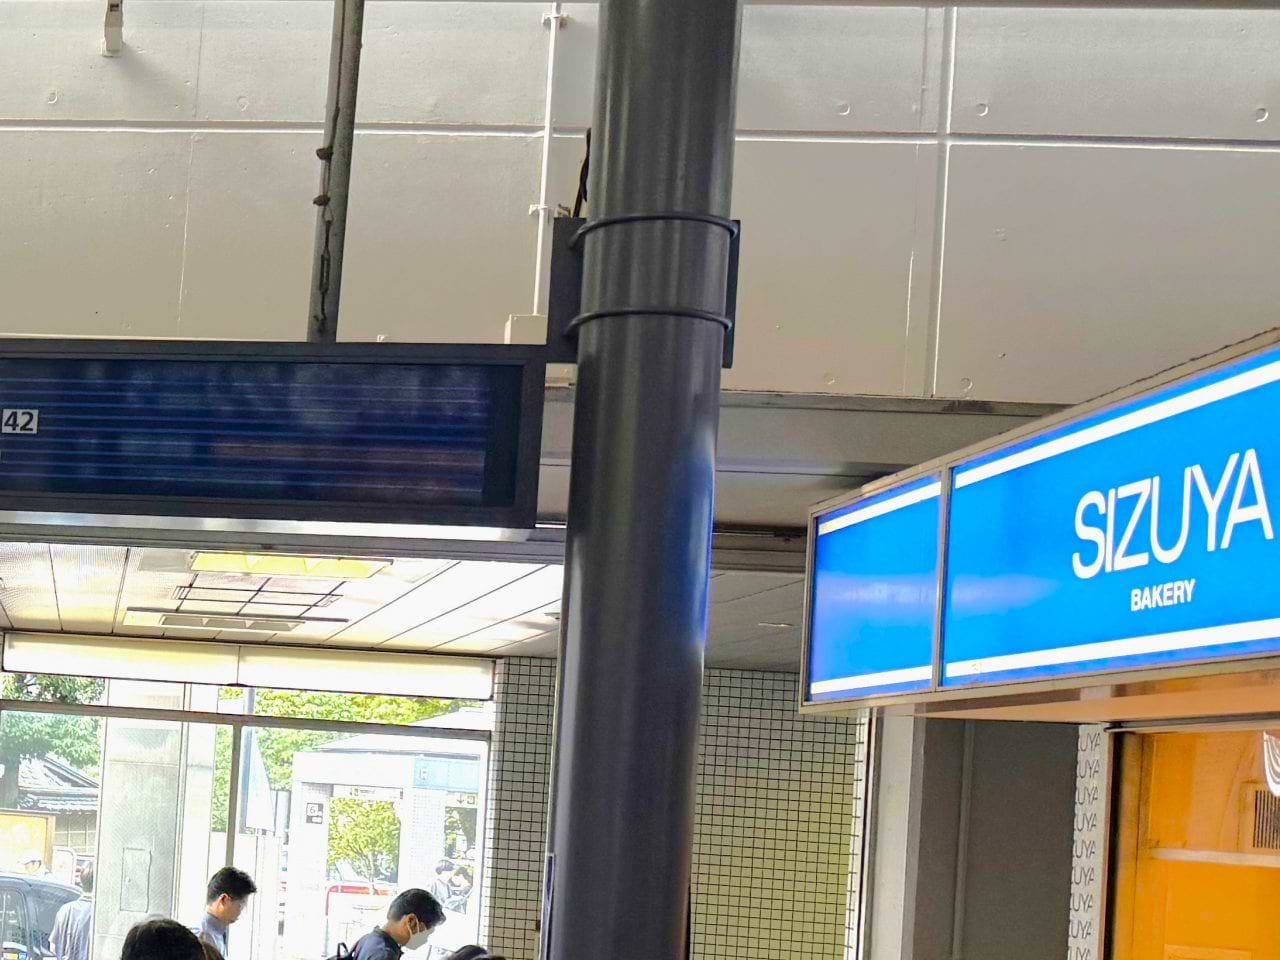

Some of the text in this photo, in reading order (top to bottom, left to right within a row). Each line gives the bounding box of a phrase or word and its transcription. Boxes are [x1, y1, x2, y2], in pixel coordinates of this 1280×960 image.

[3, 410, 35, 432] 42
[1072, 448, 1274, 579] SIZUYA
[1130, 578, 1196, 612] BAKERY
